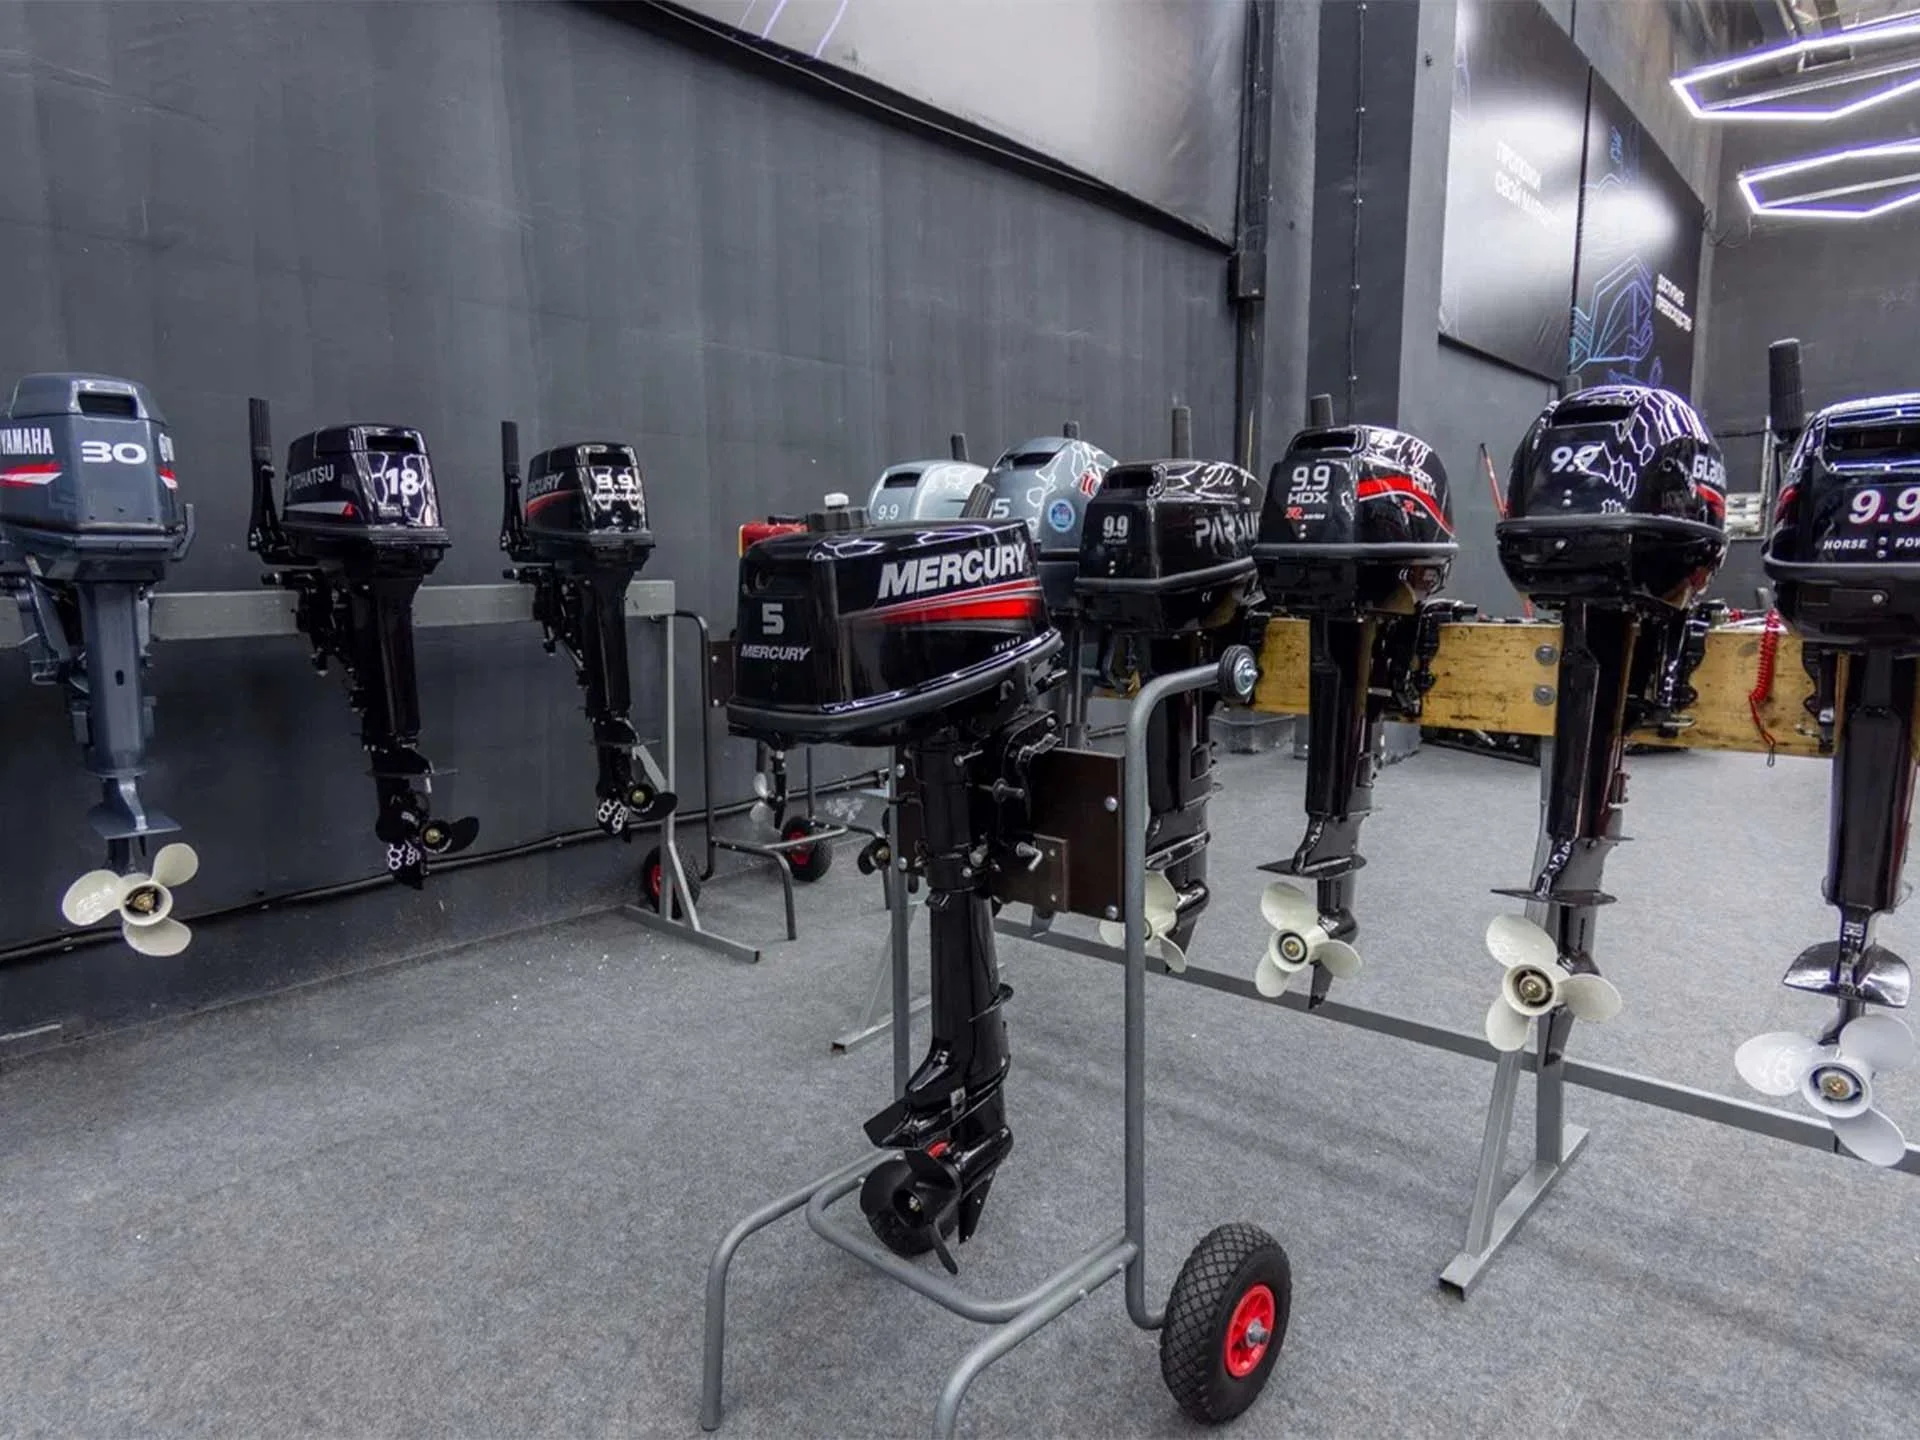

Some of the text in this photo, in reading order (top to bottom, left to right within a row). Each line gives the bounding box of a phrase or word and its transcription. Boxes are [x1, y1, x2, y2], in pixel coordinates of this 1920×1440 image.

[0, 428, 54, 455] YAMAHA
[81, 441, 147, 464] 30
[385, 468, 419, 495] 18
[1291, 465, 1331, 491] 9.9
[1287, 492, 1328, 504] HDX
[1848, 486, 1920, 524] 9.9
[878, 504, 900, 520] 9.9
[1103, 515, 1128, 538] 9.9
[1823, 538, 1868, 550] HORSE
[878, 542, 1026, 599] MERCURY
[761, 603, 784, 635] 5
[741, 644, 810, 661] MERCURY
